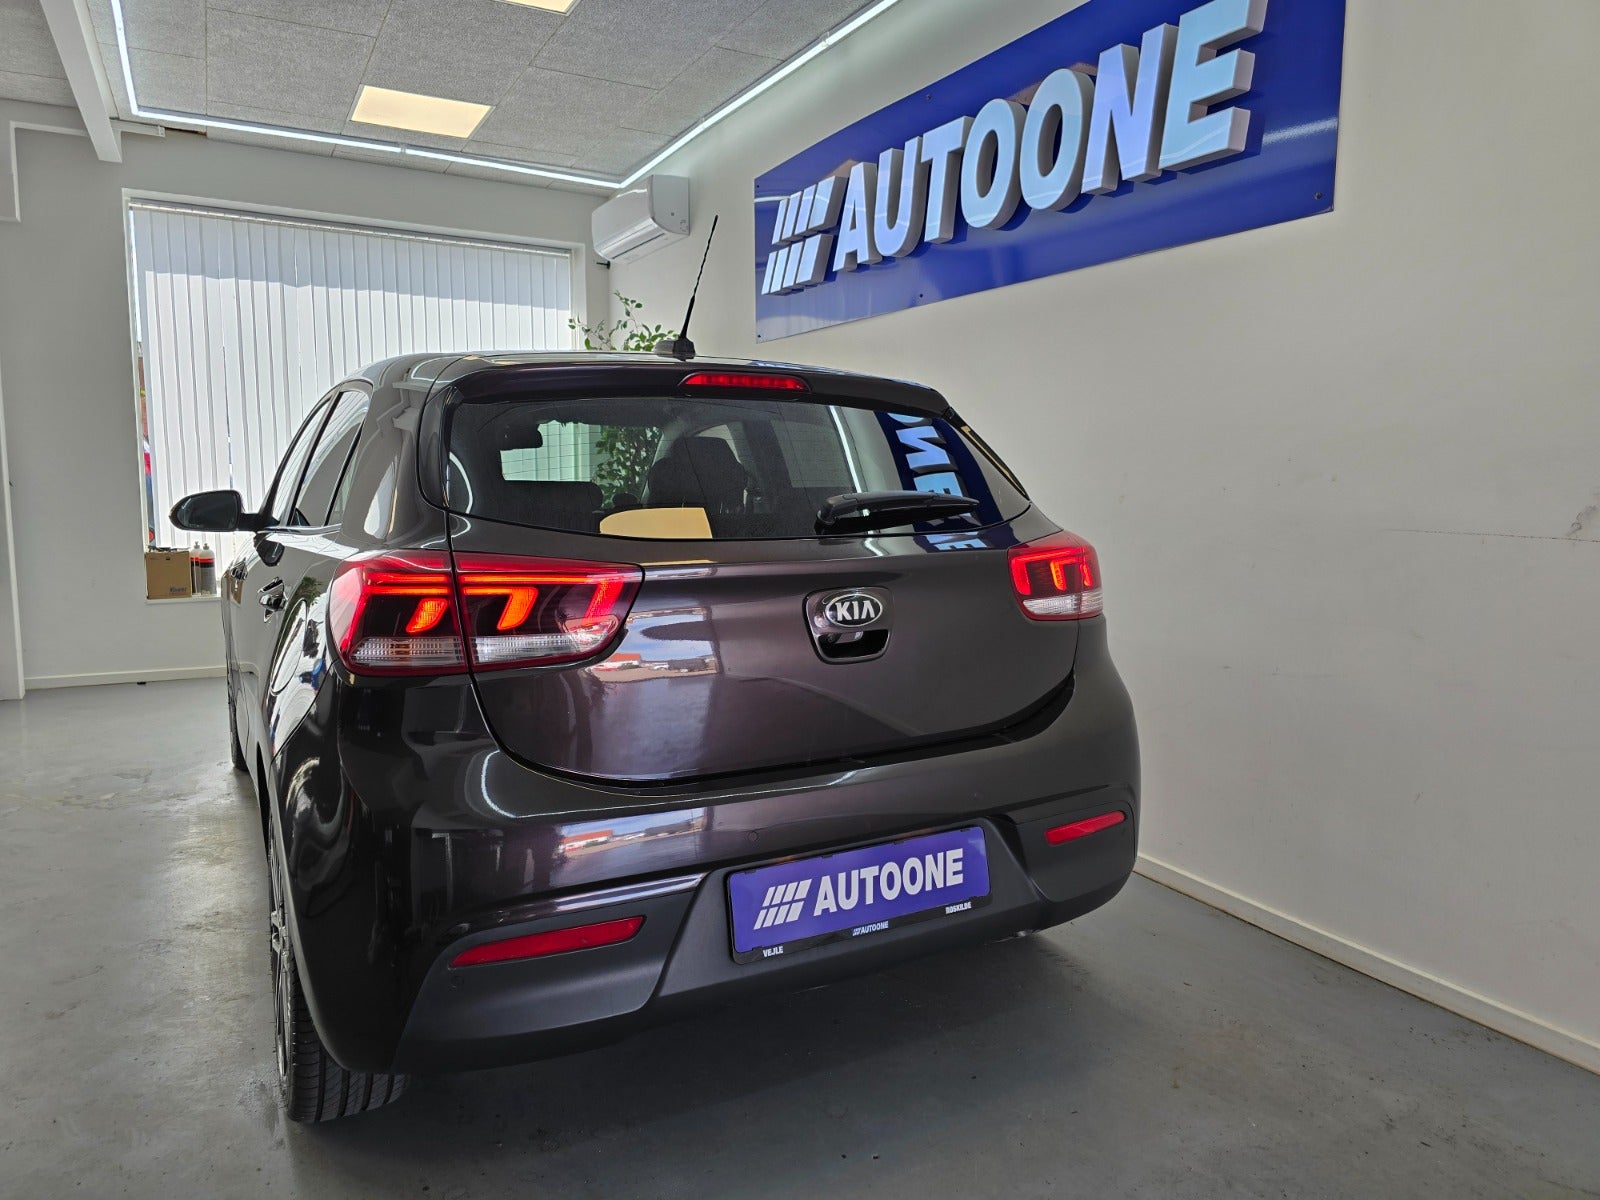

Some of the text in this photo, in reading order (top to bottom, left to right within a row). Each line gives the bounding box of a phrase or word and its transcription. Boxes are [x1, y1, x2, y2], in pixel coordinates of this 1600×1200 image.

[833, 0, 1266, 272] AUTOONE
[835, 600, 876, 622] KIA
[813, 848, 964, 917] AUTOONE
[945, 901, 972, 915] ROSKILDE
[860, 920, 889, 935] AUTOONE
[762, 945, 784, 958] VEJLE
